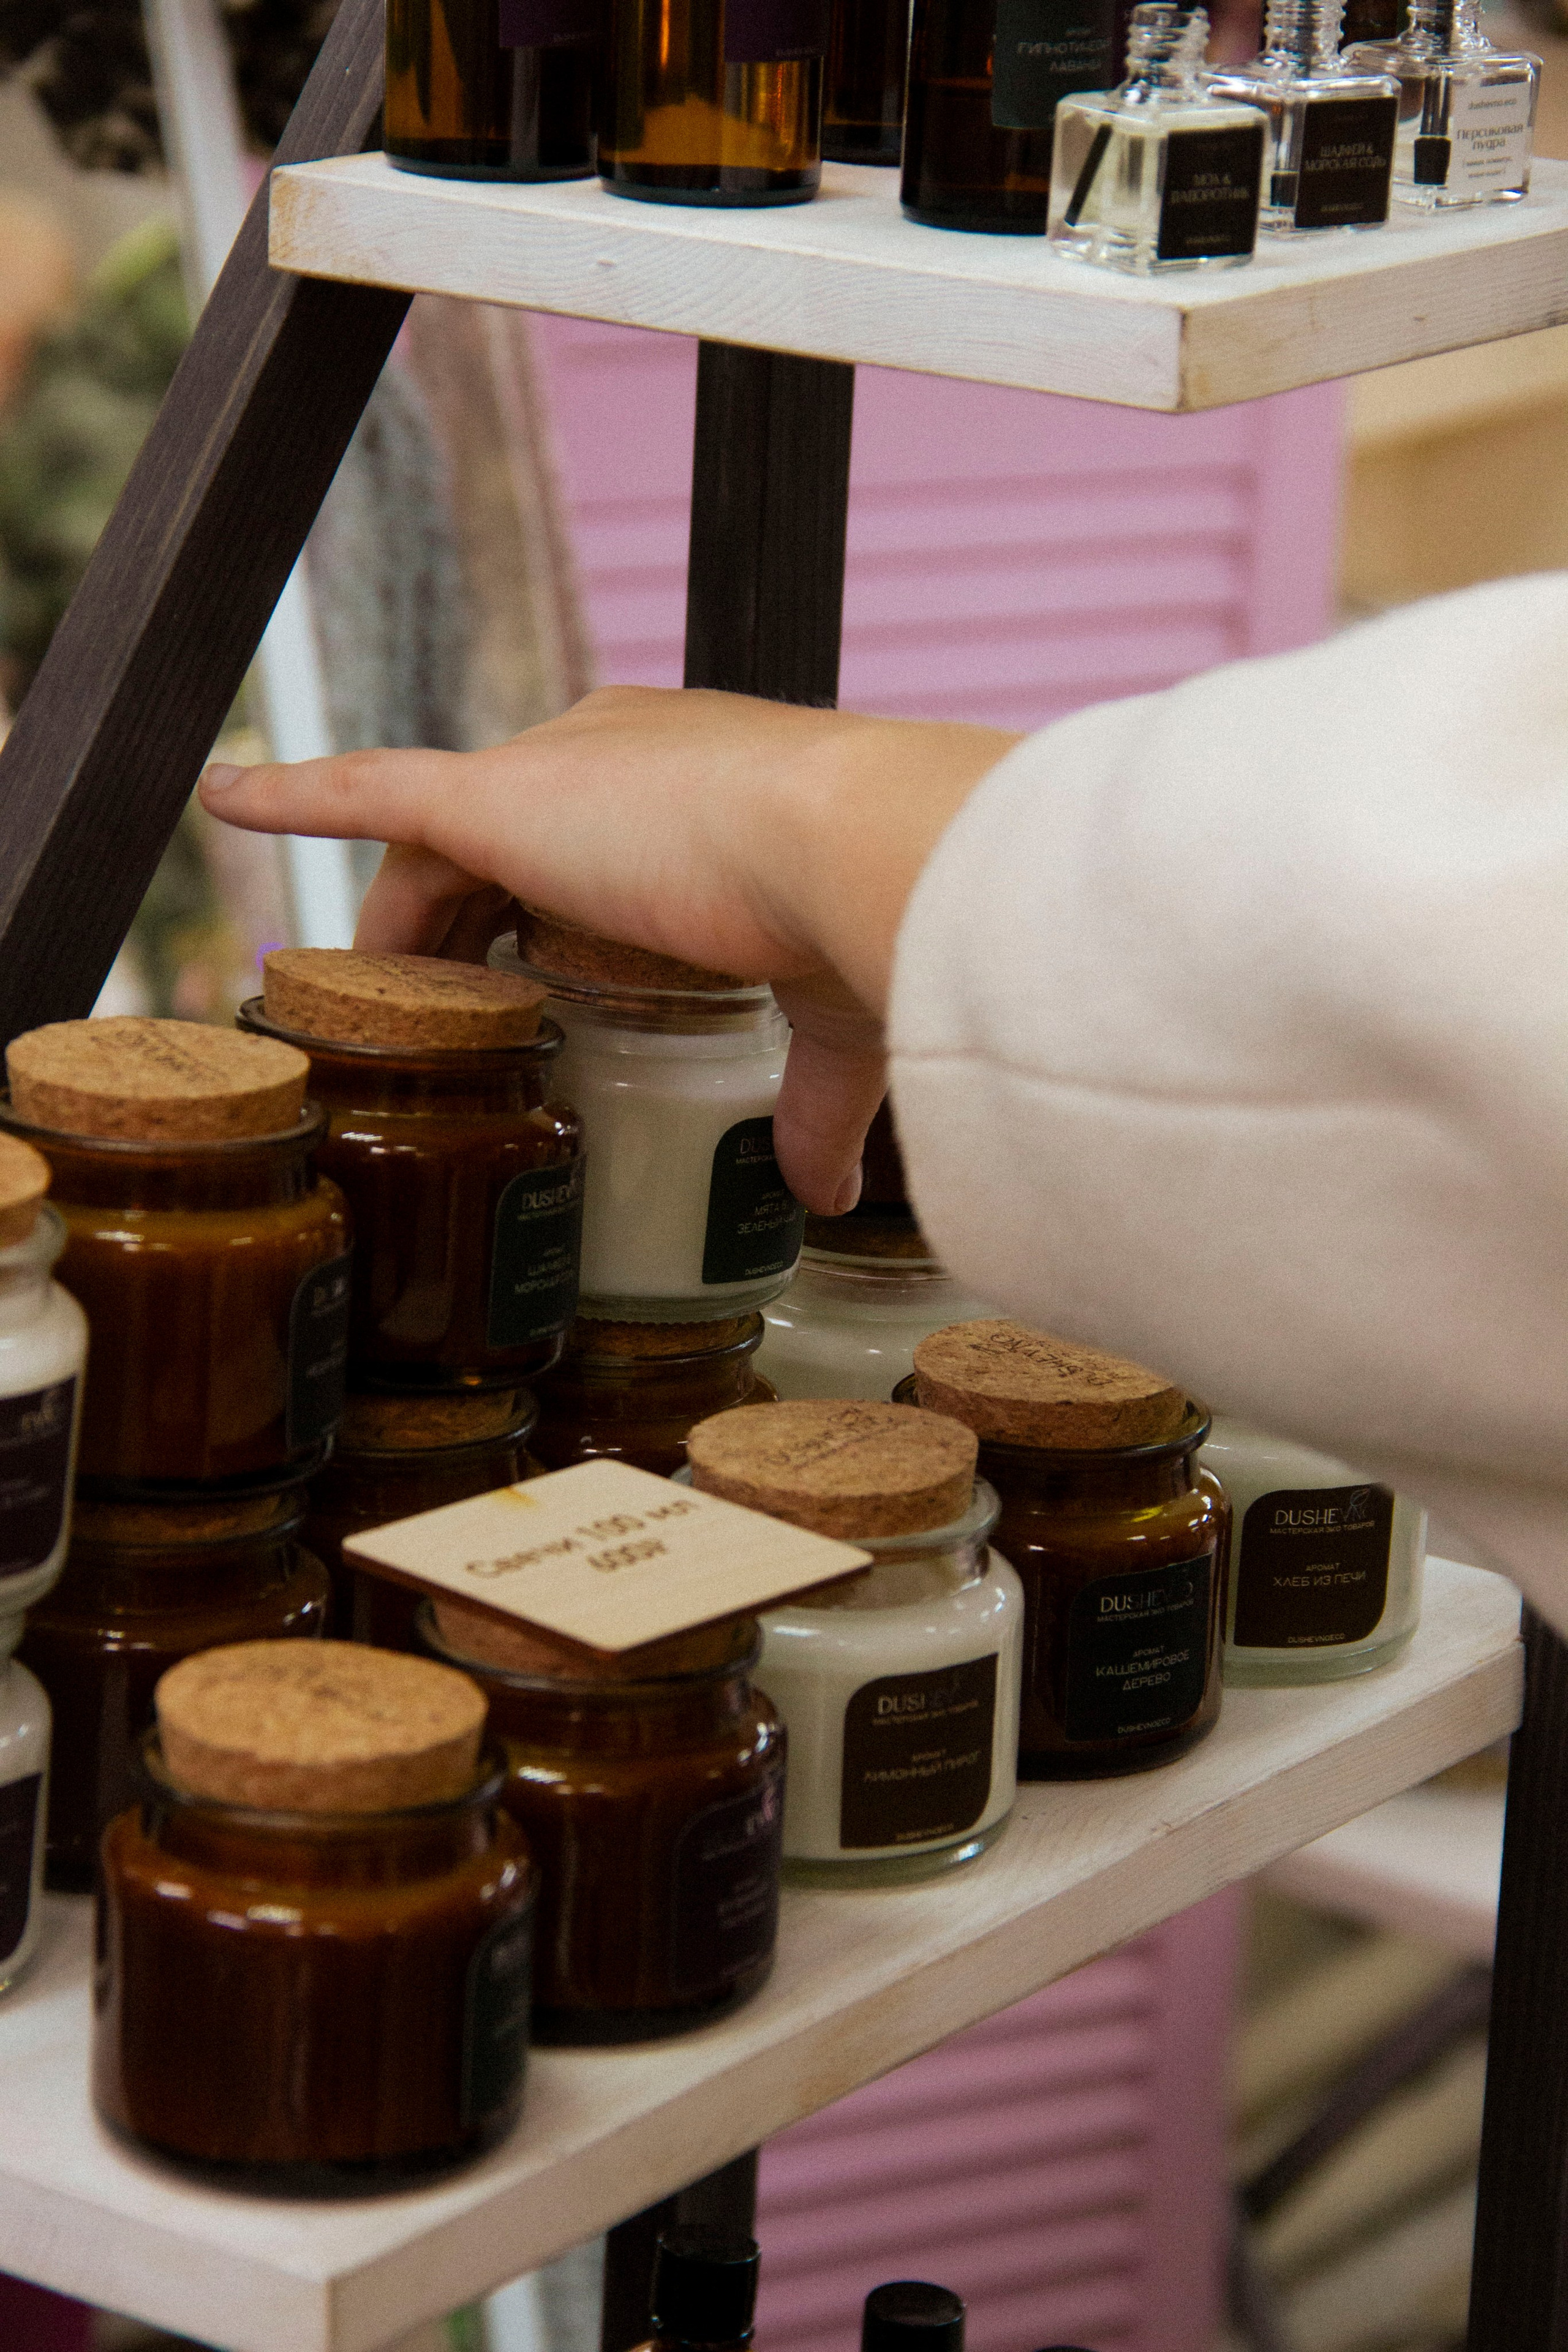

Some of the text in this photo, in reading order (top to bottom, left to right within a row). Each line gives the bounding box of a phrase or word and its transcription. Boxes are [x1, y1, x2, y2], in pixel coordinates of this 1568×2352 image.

[1457, 124, 1524, 141] Персиковая
[1320, 142, 1365, 157] ШАЛФЕЙ
[1472, 138, 1506, 151] пудра
[1304, 157, 1357, 171] МОРСКАЯ
[736, 1154, 775, 1165] МАСТЕРСКА
[754, 1202, 780, 1216] МЯТА
[737, 1215, 783, 1235] ЗЕЛЕНЫЙ
[574, 1513, 646, 1542] 100
[644, 1499, 699, 1520] мл
[1269, 1520, 1376, 1535] МАСТЕРСКАЯ ЭКО ТОВАРОВ
[1305, 1562, 1341, 1572] АРОМАТ
[1273, 1570, 1366, 1587] ХЛЕБ ИЗ ПЕЧИ
[1096, 1611, 1150, 1623] МАСТЕРСКАЯ
[1133, 1645, 1165, 1657] АРОМАТ
[1096, 1648, 1190, 1677] КАШЕМИРОВОЕ
[1122, 1671, 1172, 1691] ДЕРЕВО
